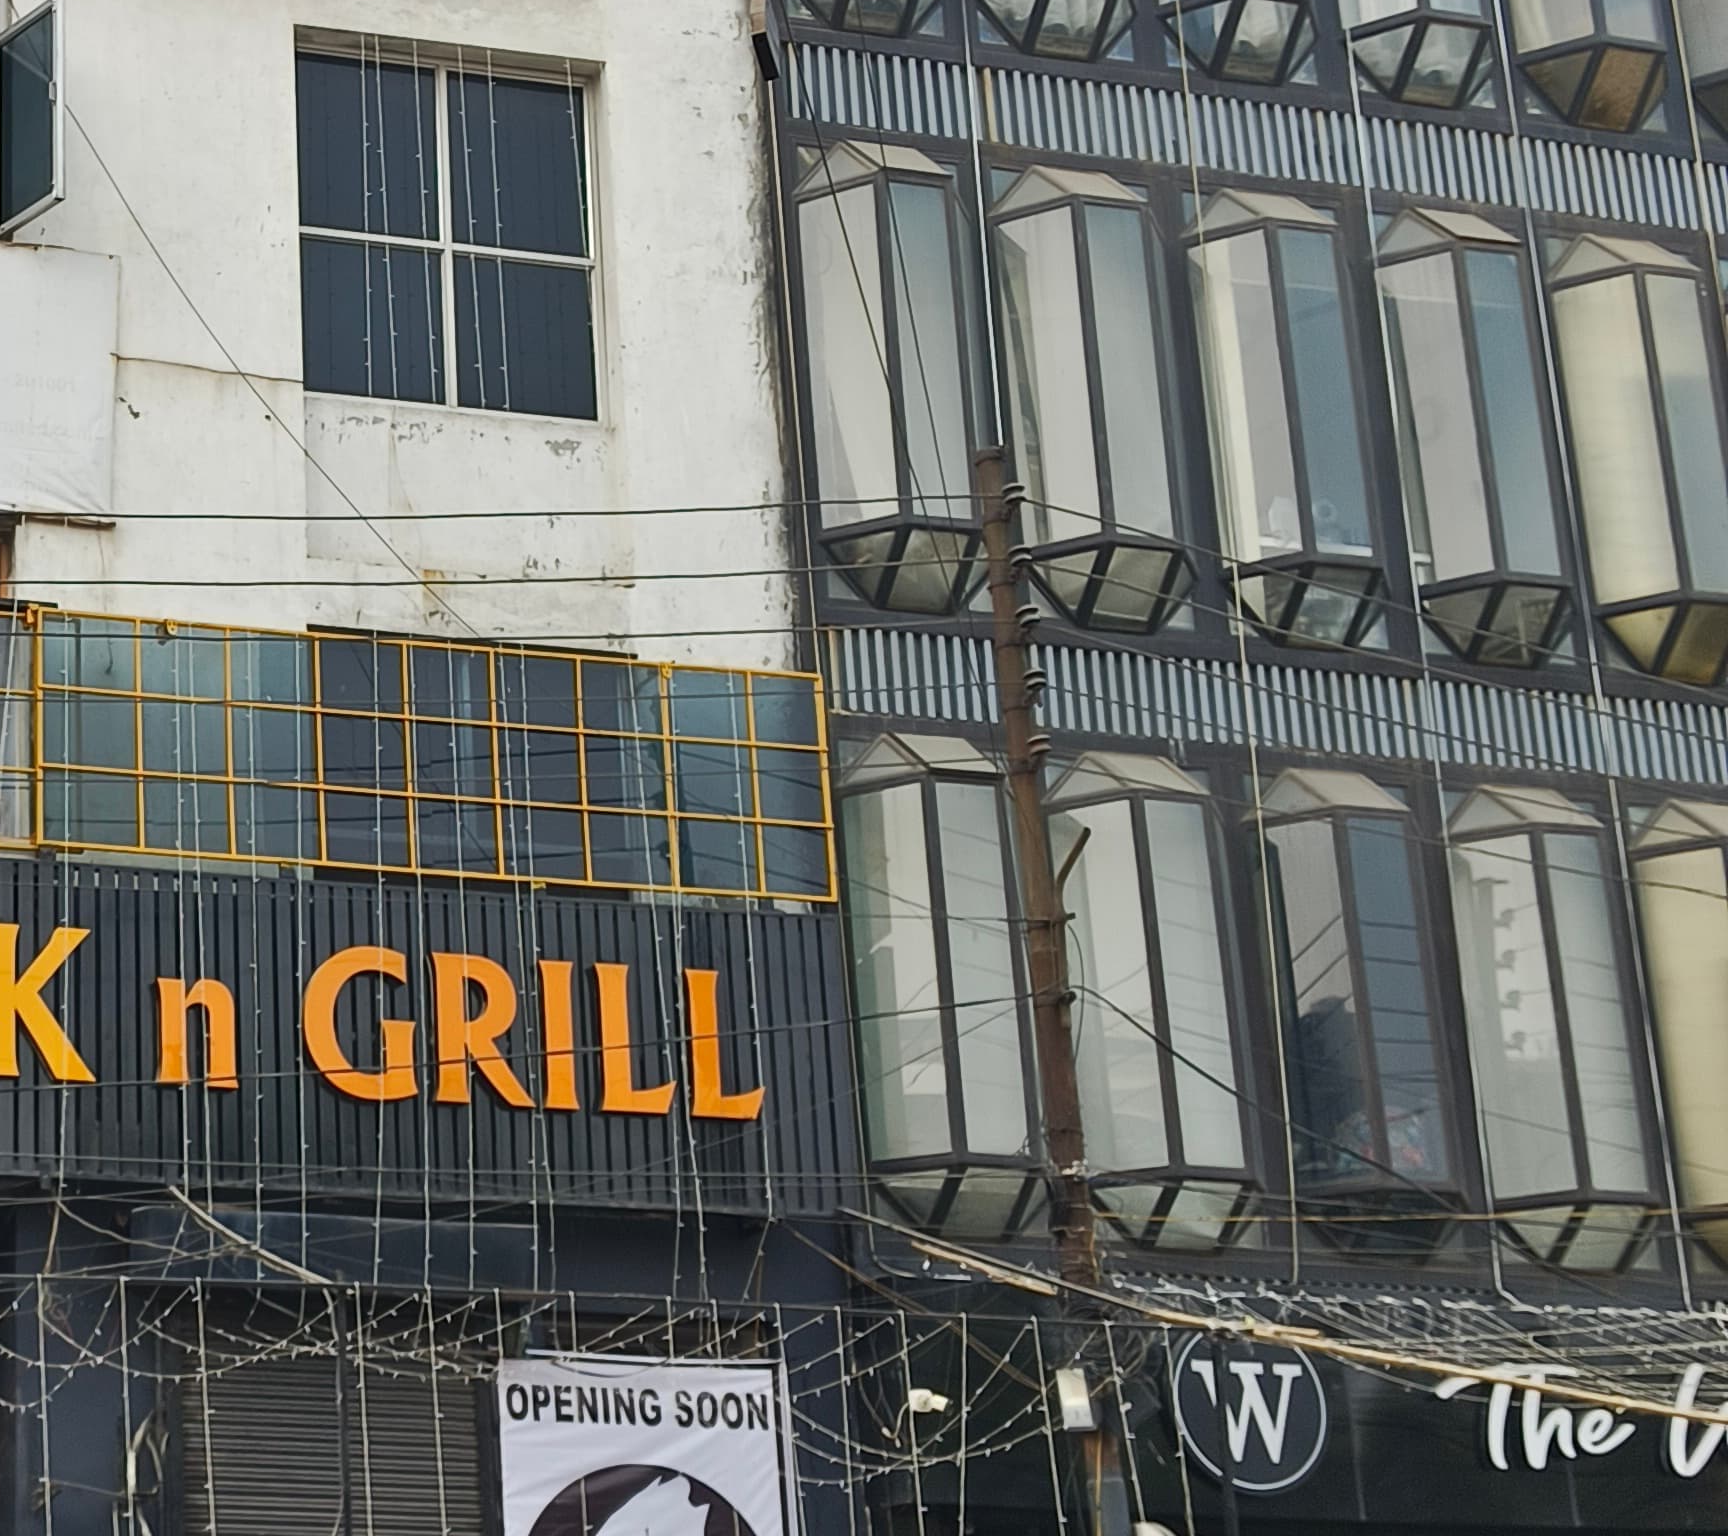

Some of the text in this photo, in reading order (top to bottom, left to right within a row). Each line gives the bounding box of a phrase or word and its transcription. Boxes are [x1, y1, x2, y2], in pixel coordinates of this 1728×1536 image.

[156, 976, 239, 1089] n
[304, 945, 766, 1121] GRILL
[505, 1383, 771, 1432] OPENING SOON
[1191, 1359, 1303, 1465] W
[1434, 1362, 1637, 1471] The
